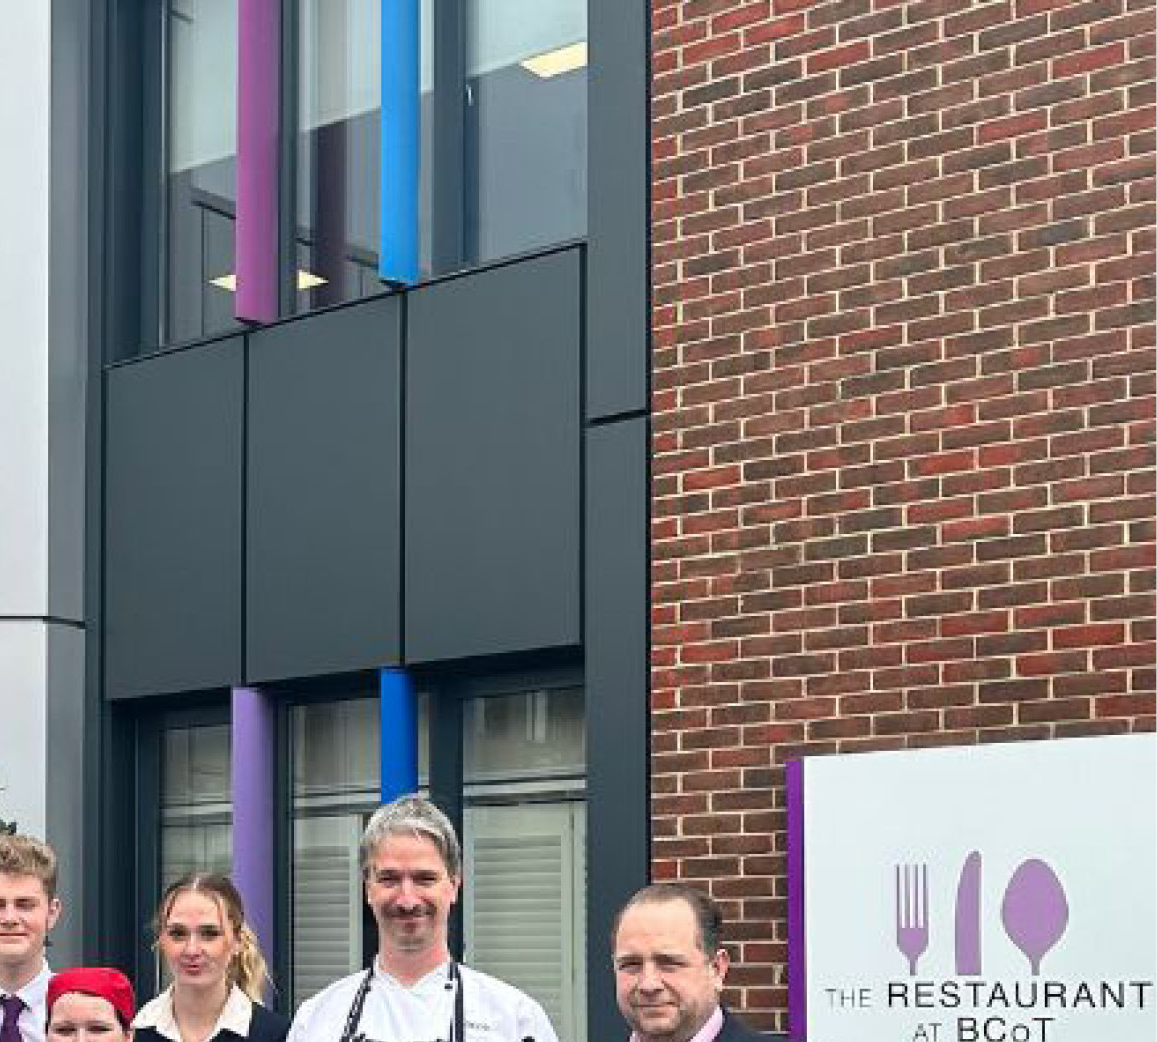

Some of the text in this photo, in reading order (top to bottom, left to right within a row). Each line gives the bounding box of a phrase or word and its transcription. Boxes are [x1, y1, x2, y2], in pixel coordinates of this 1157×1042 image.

[824, 981, 1154, 1010] THE RESTAURANT
[911, 1022, 943, 1042] AT
